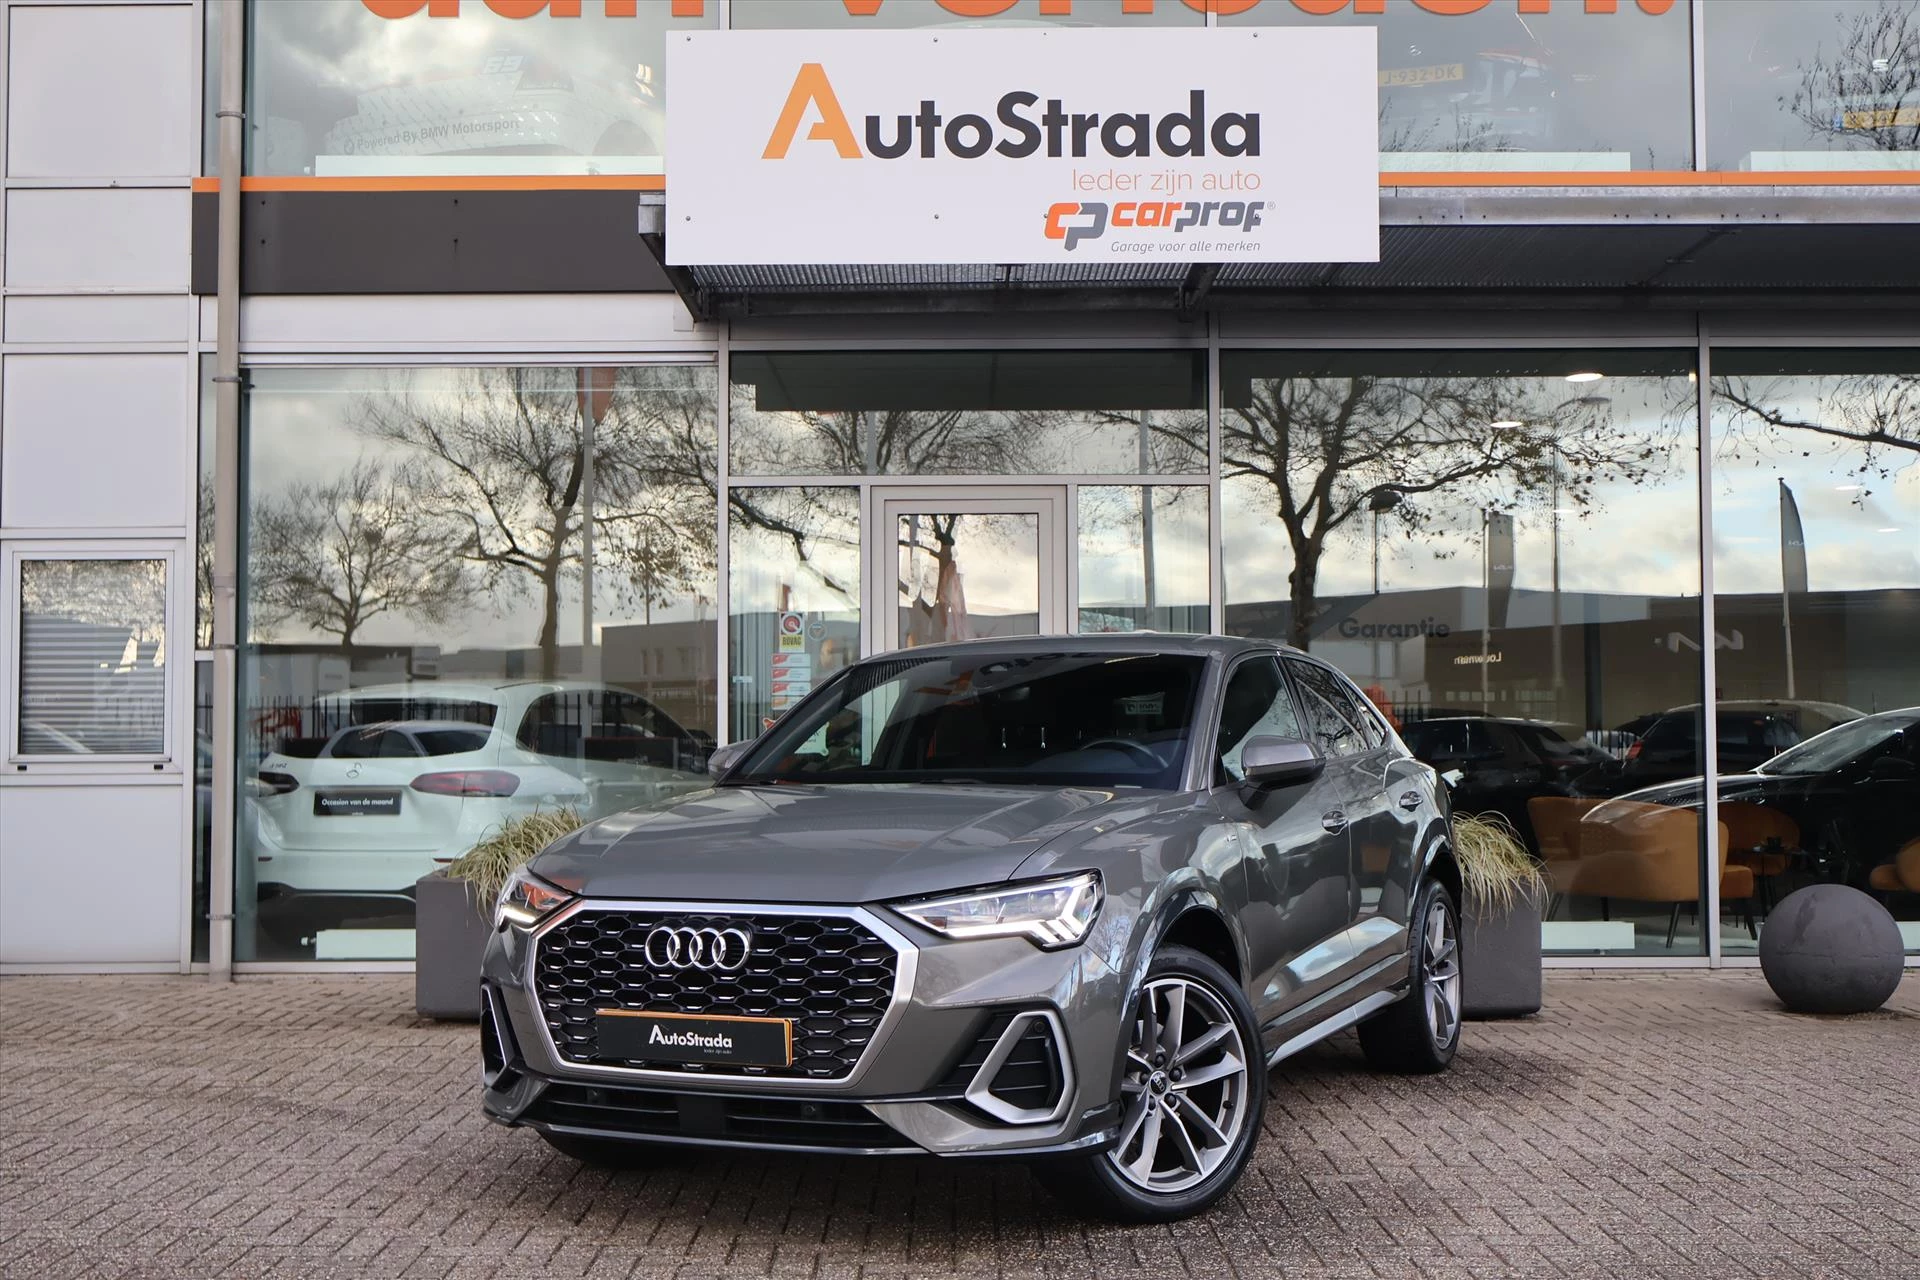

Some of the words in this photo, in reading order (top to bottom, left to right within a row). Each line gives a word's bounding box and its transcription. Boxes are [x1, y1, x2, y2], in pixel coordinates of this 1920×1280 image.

[762, 63, 1261, 160] AutoStrada
[357, 134, 400, 149] Powered
[402, 131, 417, 144] By
[420, 126, 450, 141] BMW
[452, 119, 521, 137] Motorsport
[1072, 168, 1142, 192] Ieder
[1150, 168, 1193, 197] zijn
[1201, 169, 1262, 191] auto
[1110, 241, 1154, 255] Garage
[1158, 243, 1186, 253] voor
[1189, 241, 1210, 252] alle
[1215, 241, 1261, 252] merken
[1338, 617, 1450, 639] Garantie
[321, 798, 349, 806] Occasion
[362, 798, 371, 806] de
[371, 798, 394, 806] maand
[648, 1024, 733, 1048] AutoStrada
